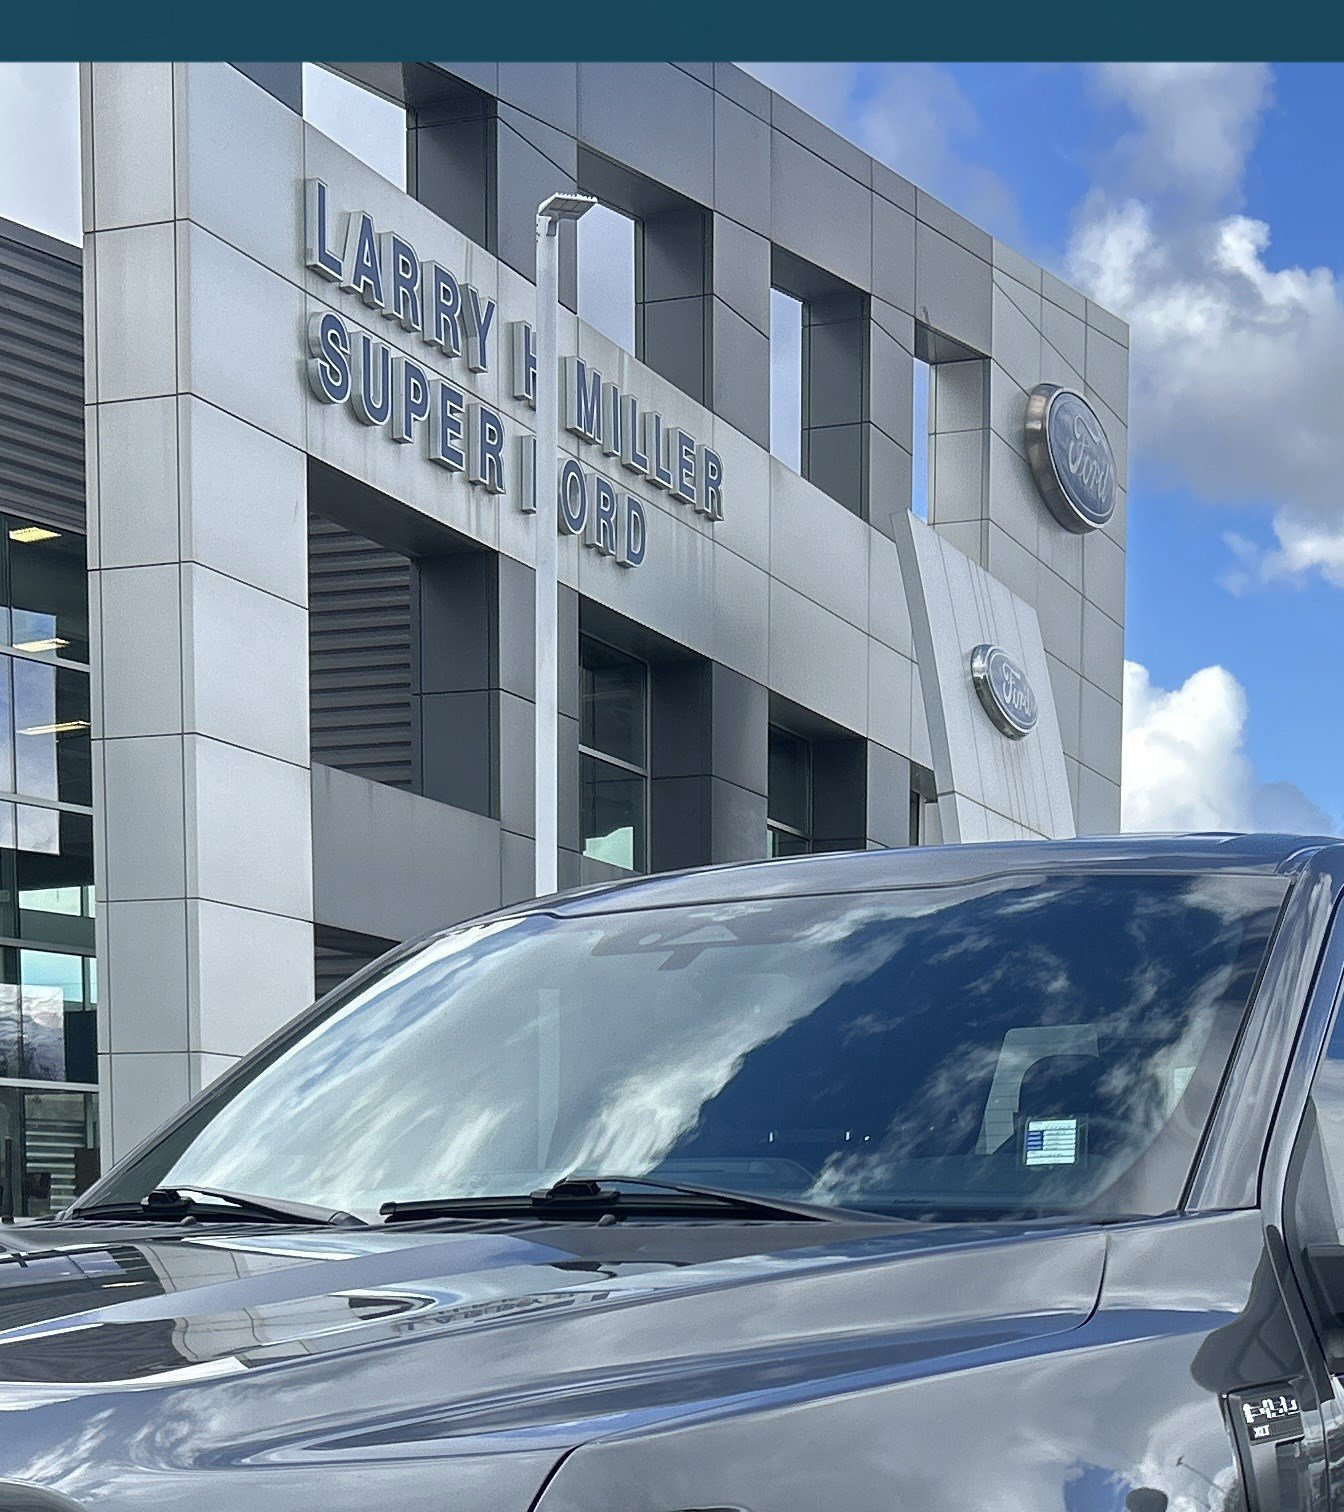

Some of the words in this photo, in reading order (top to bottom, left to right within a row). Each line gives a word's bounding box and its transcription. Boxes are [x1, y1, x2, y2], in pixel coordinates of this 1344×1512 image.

[307, 177, 496, 374] LARRY
[565, 355, 725, 522] MILLER
[308, 310, 506, 495] SUPER
[520, 434, 649, 568] ORD
[1068, 415, 1115, 503] Ford
[1002, 662, 1036, 718] Ford
